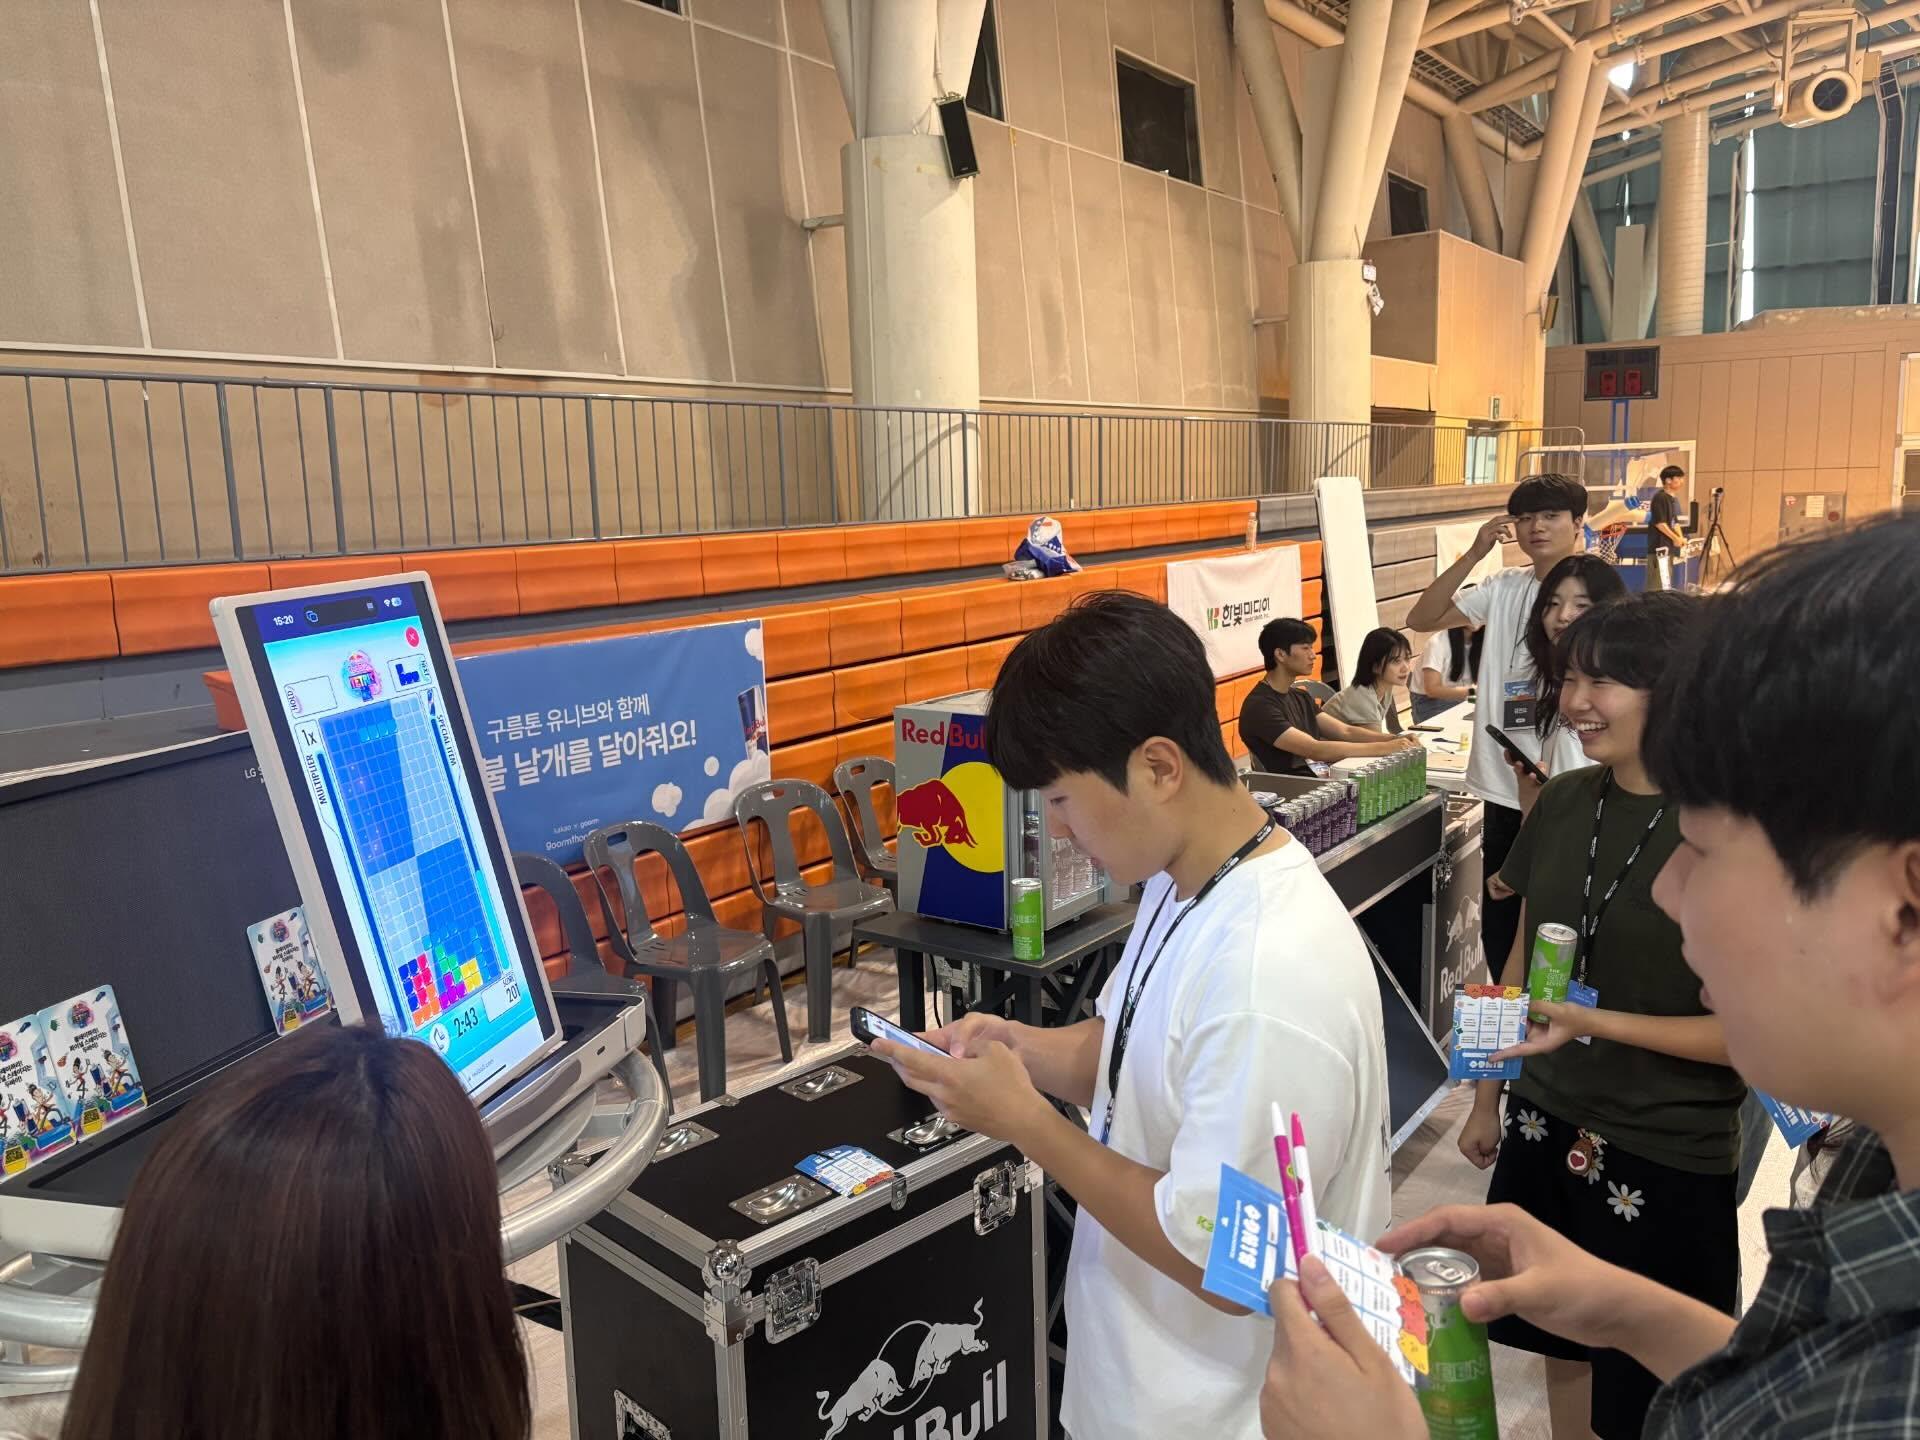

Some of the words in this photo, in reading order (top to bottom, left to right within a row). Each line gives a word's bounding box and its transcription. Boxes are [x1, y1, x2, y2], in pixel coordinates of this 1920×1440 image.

[273, 615, 294, 626] 15:20
[487, 712, 543, 743] 구름톤
[546, 700, 613, 733] 유니브와
[617, 693, 650, 720] 함께
[902, 719, 945, 746] Red
[949, 723, 986, 750] Bul
[514, 738, 592, 786] 날개를
[599, 719, 697, 767] 달아줘요!
[245, 767, 256, 779] LG
[305, 754, 327, 805] MULTIPLIER
[1440, 950, 1463, 1003] Red
[453, 1007, 479, 1037] 2:43
